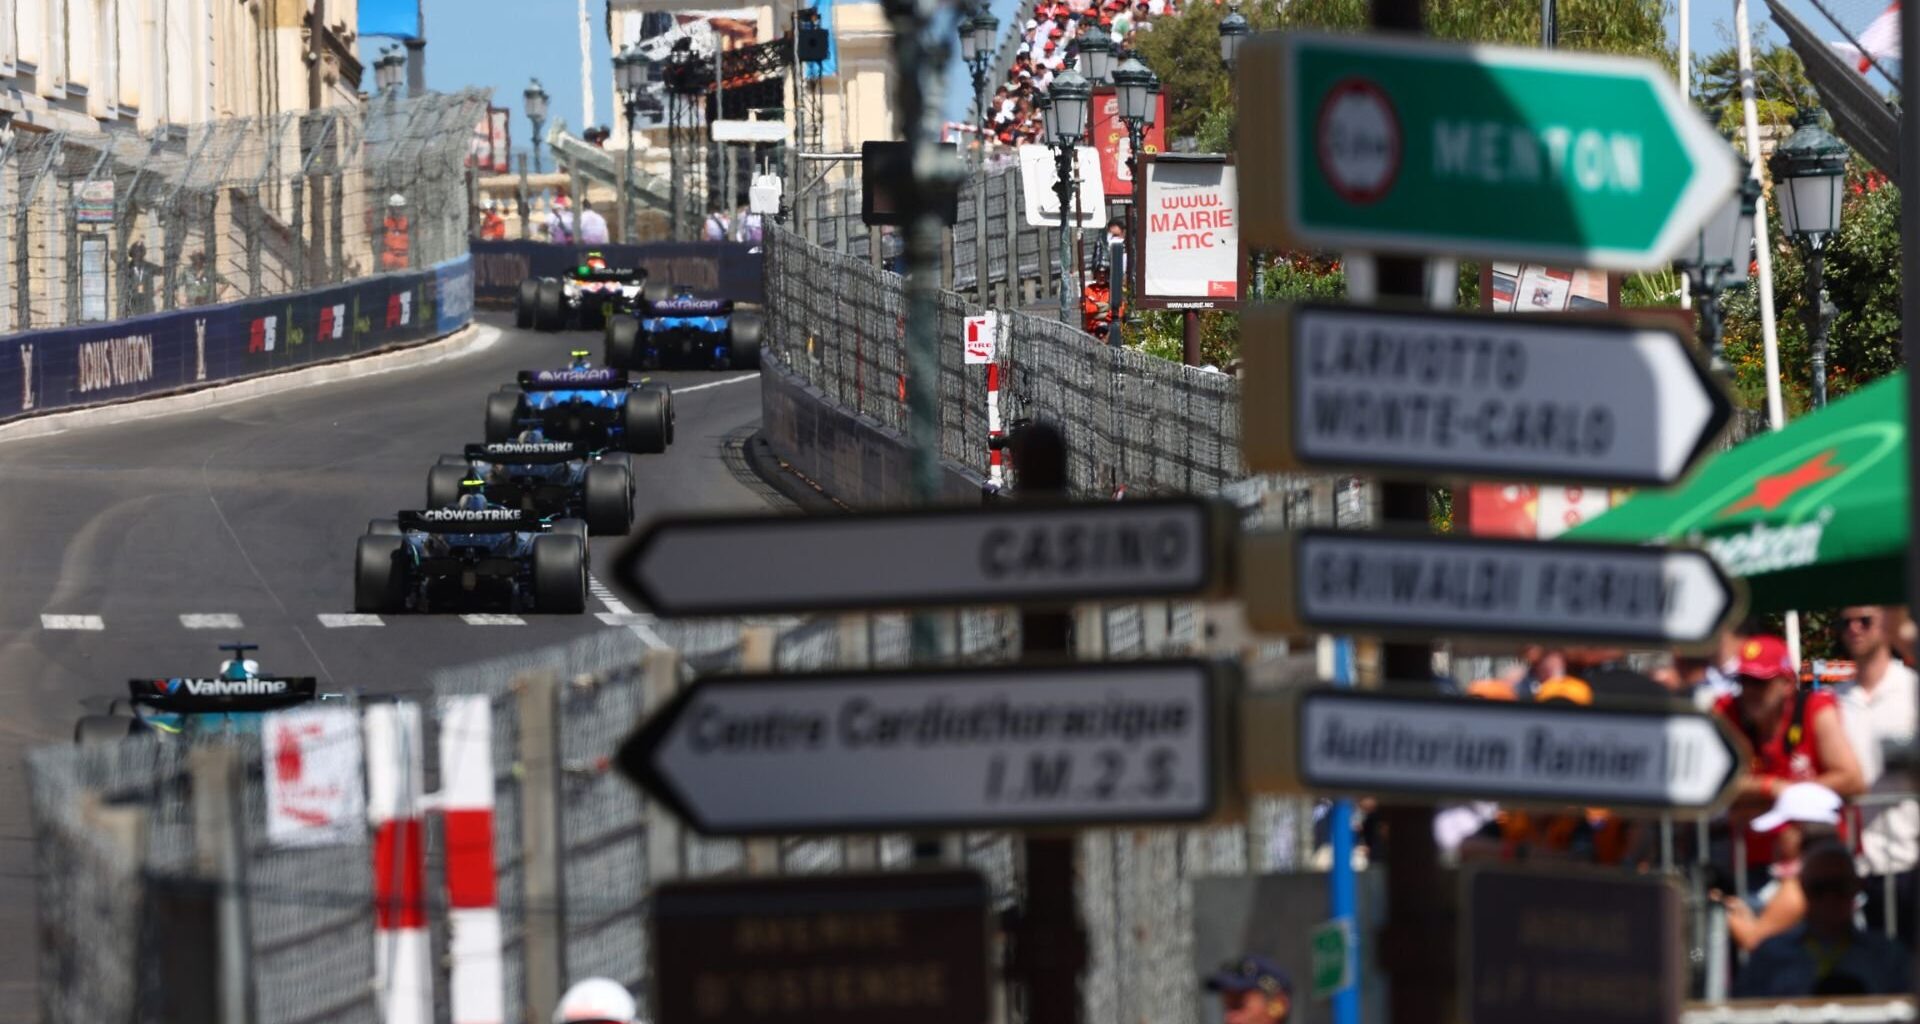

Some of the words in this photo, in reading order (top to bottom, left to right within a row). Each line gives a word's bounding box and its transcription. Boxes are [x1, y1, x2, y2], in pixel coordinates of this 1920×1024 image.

[1431, 116, 1643, 193] MENTON
[1151, 208, 1234, 233] MAIRIE
[1161, 193, 1223, 209] www.
[1172, 231, 1214, 250] .mc
[79, 340, 111, 393] LOUIS
[110, 333, 153, 385] VUITTON
[1308, 325, 1528, 392] LARVOTTO
[487, 442, 574, 454] CROWDSTRIKE
[1311, 388, 1617, 456] MONTE-CARLO
[424, 508, 522, 521] CROWDSTRIKE
[976, 517, 1190, 581] CASINO
[1312, 550, 1524, 613] GRIMALDI
[1533, 560, 1680, 619] FORUM
[185, 678, 288, 695] Valvoline
[688, 703, 825, 752] Centre
[838, 693, 1191, 749] Cardiothoracique
[1320, 703, 1508, 773] Auditorium
[1522, 722, 1652, 781] Rainier
[985, 745, 1192, 801] I.M.2.S.
